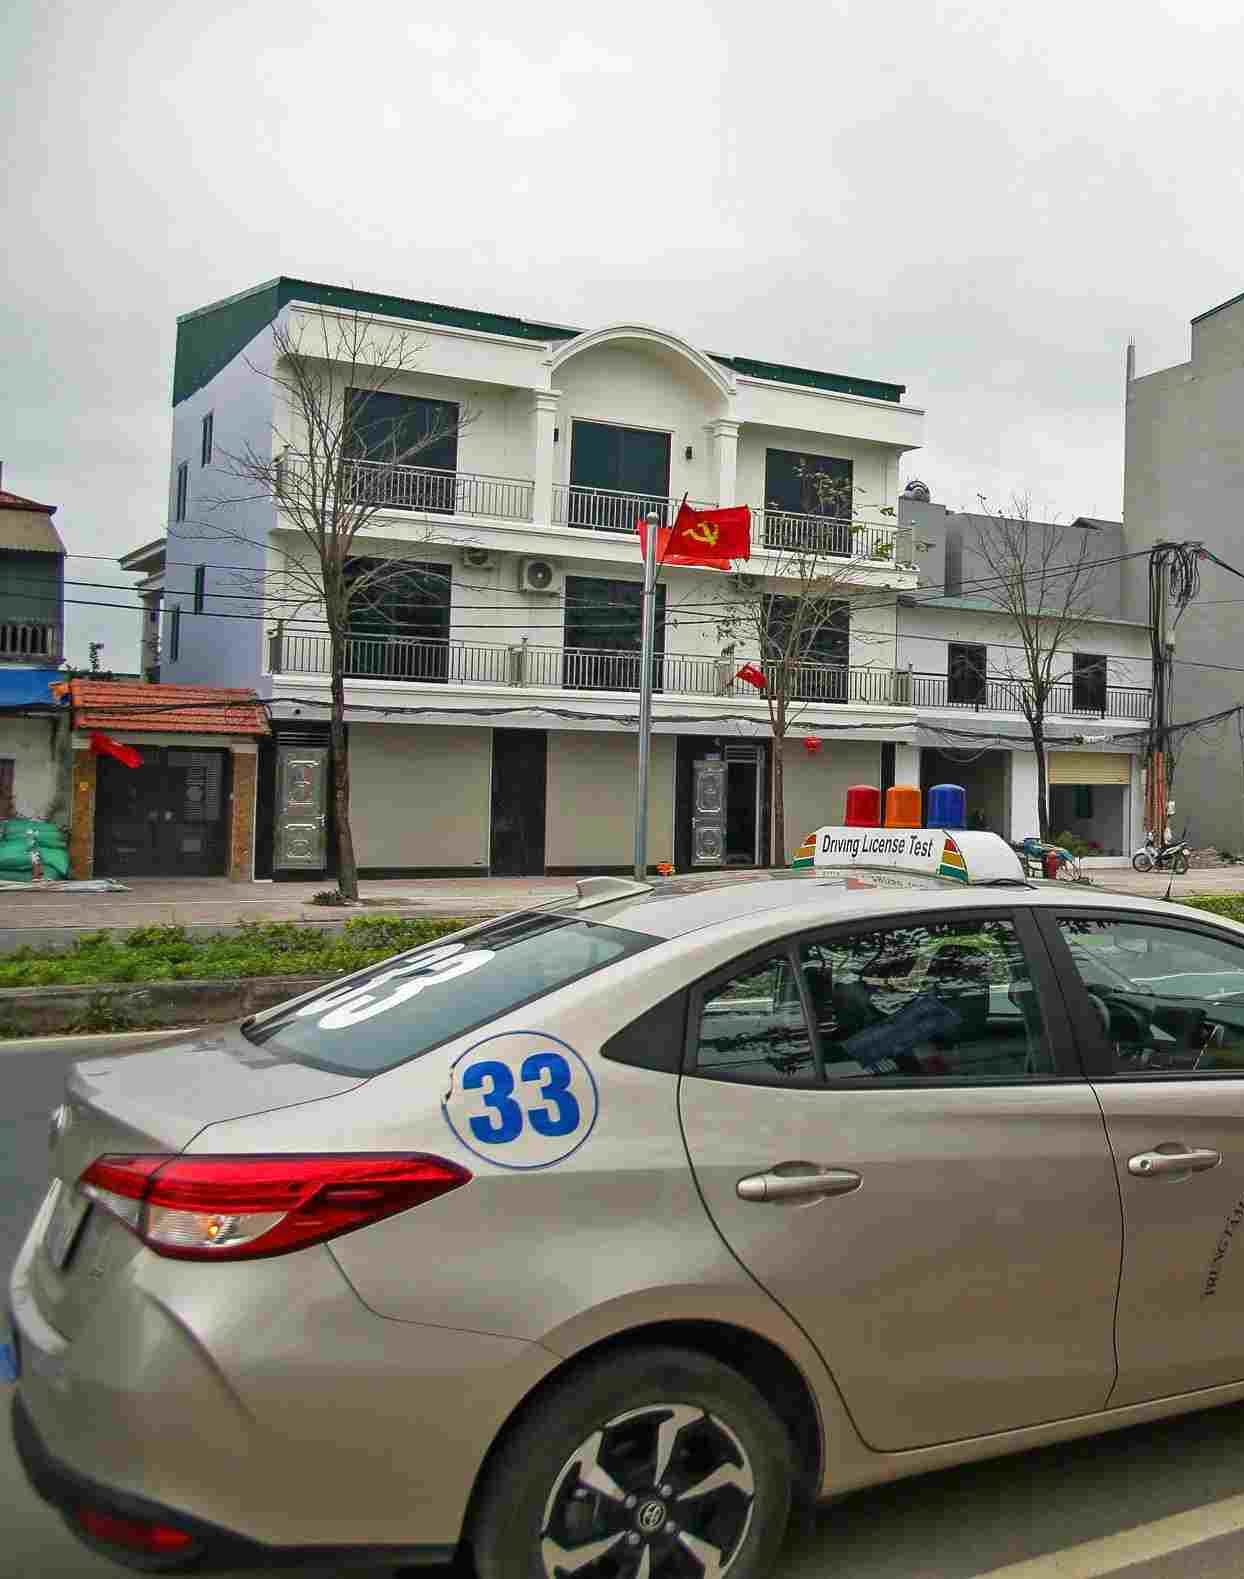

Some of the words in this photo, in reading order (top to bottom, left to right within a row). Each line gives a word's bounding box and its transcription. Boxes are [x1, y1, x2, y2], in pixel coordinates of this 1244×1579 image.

[822, 834, 859, 857] Driving
[861, 835, 905, 854] License
[908, 835, 933, 857] Test
[462, 1051, 580, 1145] 33
